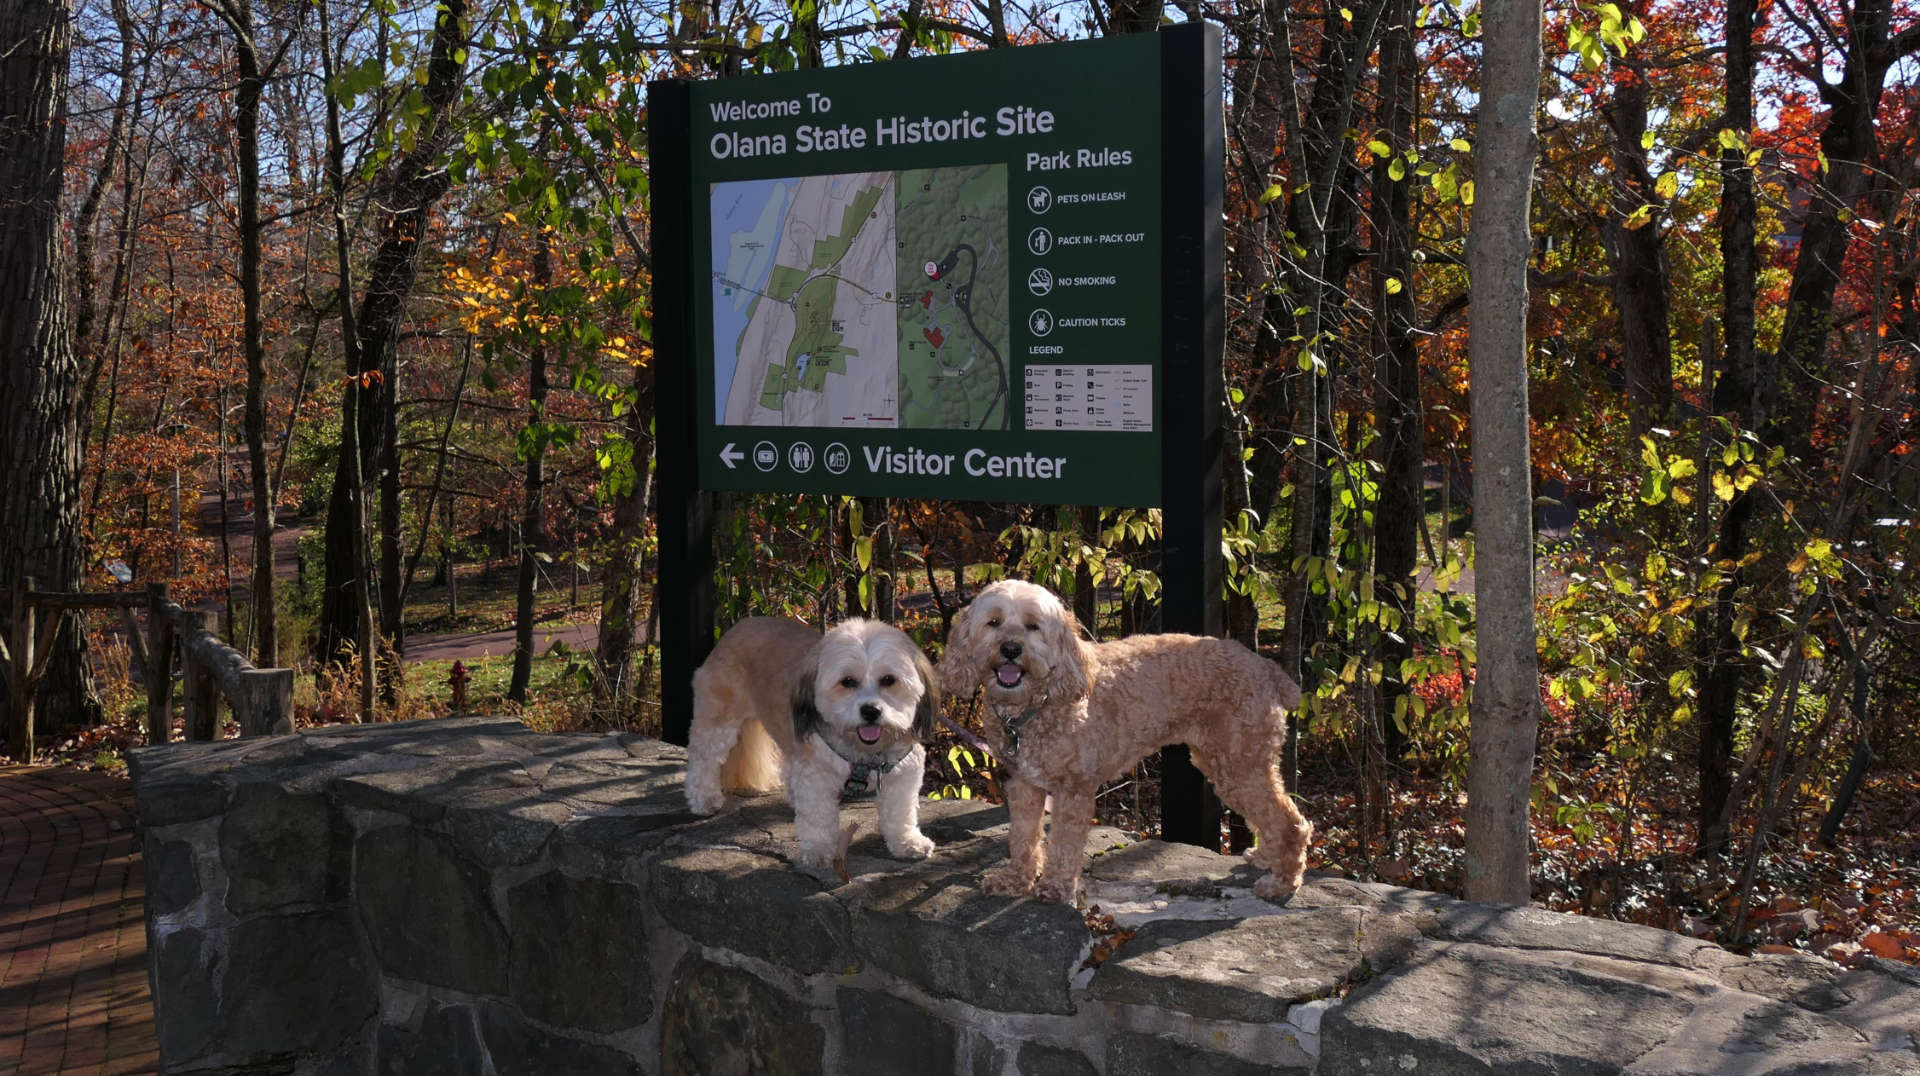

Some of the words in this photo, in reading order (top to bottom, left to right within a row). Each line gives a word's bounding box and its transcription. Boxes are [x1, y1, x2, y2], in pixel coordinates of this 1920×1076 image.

[711, 101, 801, 122] Welcome
[807, 93, 832, 113] To
[711, 132, 787, 159] Olana
[796, 125, 867, 153] State
[877, 111, 987, 146] Historic
[997, 106, 1055, 136] Site
[1027, 151, 1070, 171] Park
[1078, 148, 1133, 168] Rules
[1057, 194, 1080, 203] PETS
[1081, 193, 1096, 203] ON
[1097, 192, 1126, 202] LEASH
[1058, 236, 1081, 245] PACK
[1083, 235, 1093, 244] IN
[1099, 234, 1124, 244] PACK
[1125, 233, 1145, 243] OUT
[1058, 277, 1073, 286] NO
[1074, 276, 1116, 286] SMOKING
[1058, 318, 1099, 327] CAUTION
[1100, 317, 1126, 327] TICKS
[1029, 345, 1064, 355] LEGEND
[863, 446, 954, 475] Visitor
[964, 448, 1067, 479] Center
